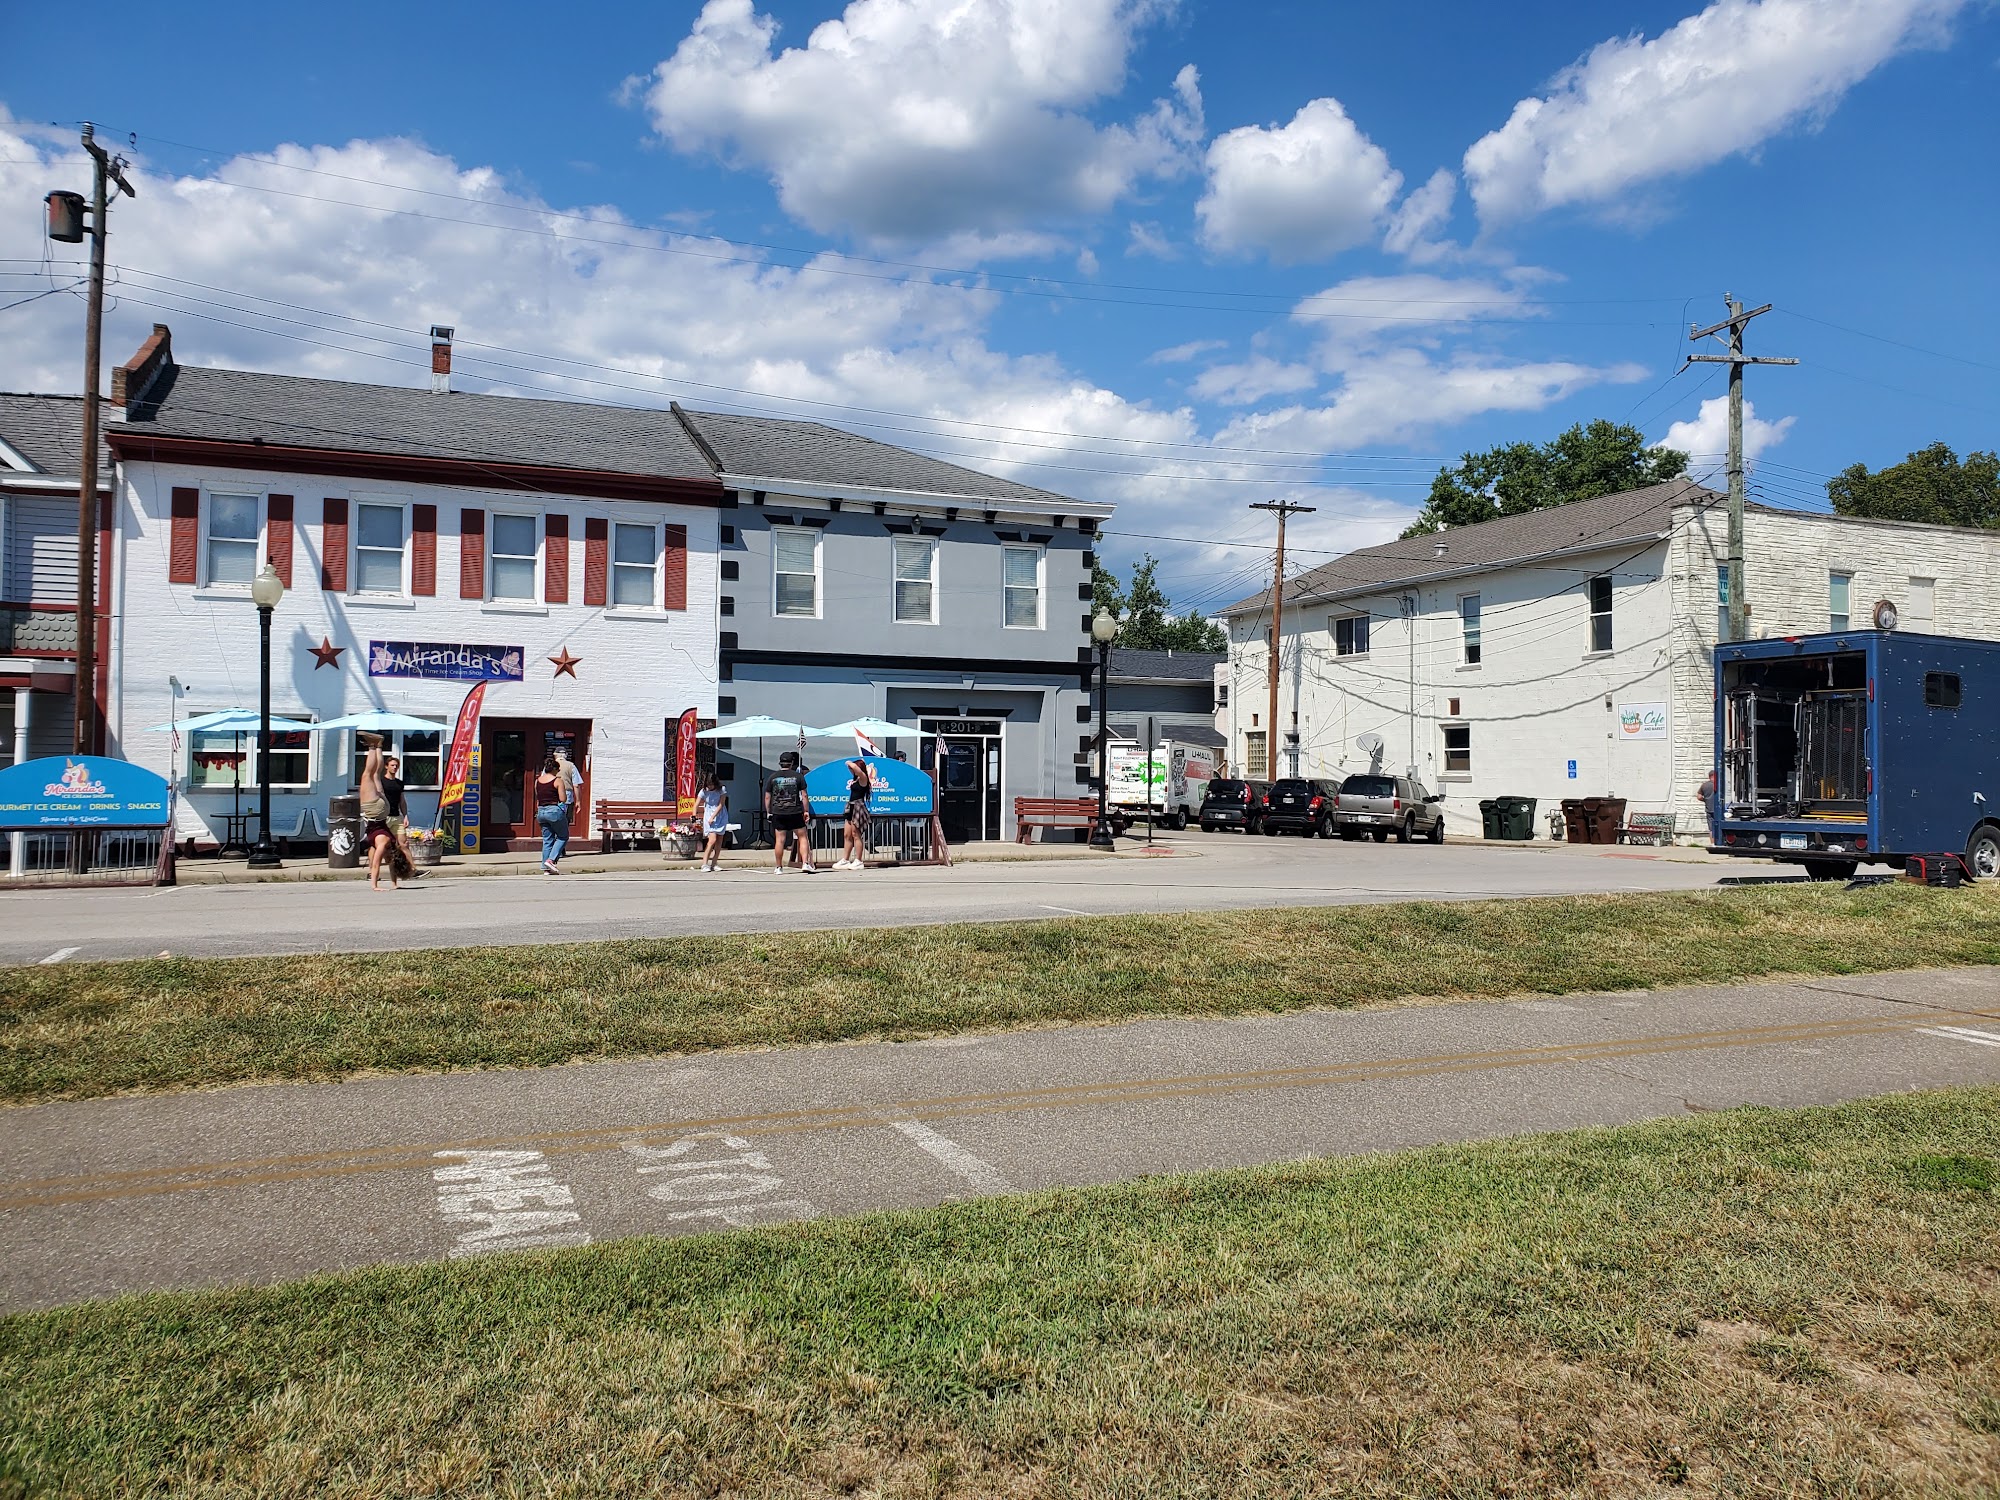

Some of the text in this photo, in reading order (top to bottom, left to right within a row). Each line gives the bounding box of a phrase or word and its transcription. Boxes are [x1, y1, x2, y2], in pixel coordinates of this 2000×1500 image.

[393, 645, 501, 676] Miranda's
[950, 722, 971, 733] 201
[1643, 710, 1665, 726] Cafe
[451, 699, 479, 782] OPEN
[681, 721, 692, 797] OPEN
[1191, 750, 1211, 761] U-HAUL
[44, 781, 106, 796] Miranda's
[444, 786, 463, 799] NOW
[462, 783, 480, 827] FOOD
[620, 1132, 822, 1228] STOP
